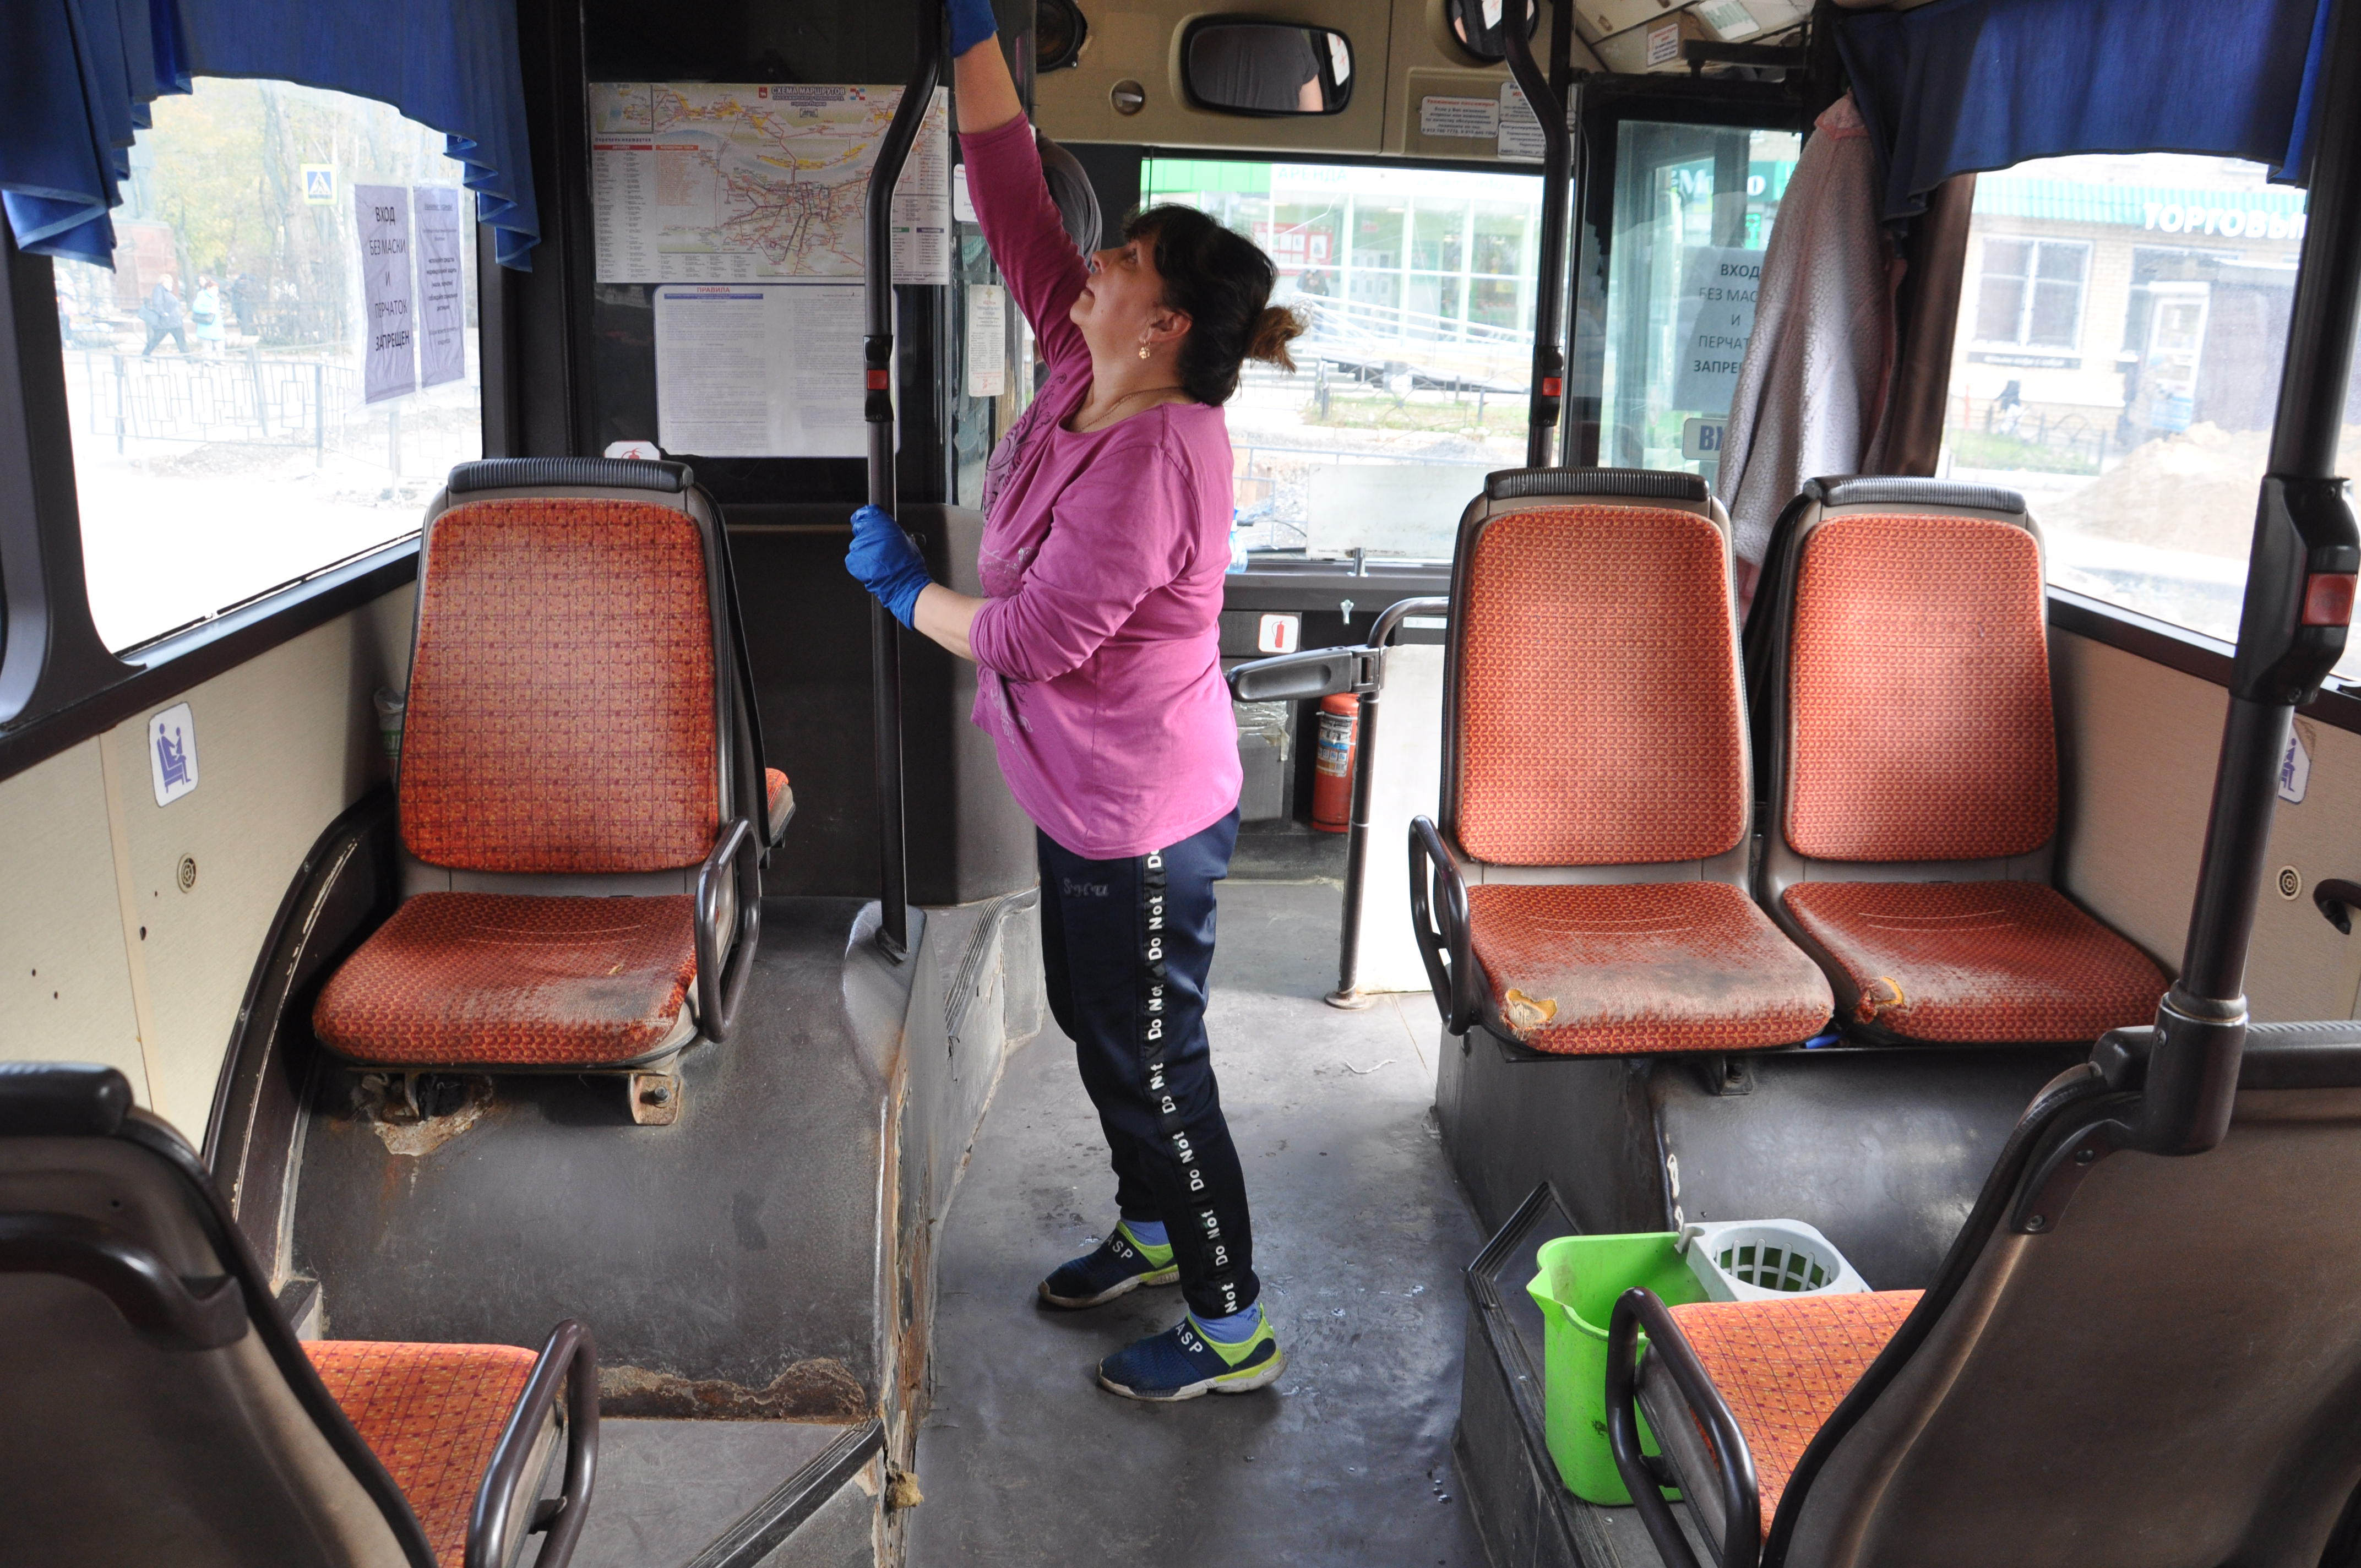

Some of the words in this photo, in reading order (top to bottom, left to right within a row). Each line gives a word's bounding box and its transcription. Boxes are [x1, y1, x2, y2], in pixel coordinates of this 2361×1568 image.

[772, 86, 797, 95] СХЕМА
[799, 86, 846, 95] МАРШРУТОВ
[1277, 166, 1347, 183] АРЕНДА
[376, 206, 396, 226] ВХОД
[369, 239, 382, 256] БЕЗ
[382, 238, 406, 255] МАСКИ
[385, 271, 391, 287] И
[1721, 264, 1760, 280] ВХОД
[1699, 287, 1722, 300] БЕЗ
[1727, 289, 1759, 302] МАС
[374, 298, 407, 319] ПЕРЧАТОК
[1731, 314, 1740, 326] И
[376, 330, 410, 352] ЗАПРЕЩЕН
[1699, 335, 1749, 350] ПЕРЧАТ
[1694, 360, 1742, 374] ЗАПРЕ
[1699, 425, 1724, 451] ВХ
[1149, 895, 1163, 930] Not
[1149, 937, 1162, 961] Do
[1148, 984, 1164, 1012] Not
[1148, 1019, 1162, 1040] Do
[1162, 1095, 1177, 1114] Do
[1172, 1131, 1194, 1164] Not
[1190, 1169, 1204, 1192] Do
[1201, 1209, 1220, 1240] Not
[1215, 1245, 1228, 1266] Do
[1221, 1282, 1238, 1314] Not
[1175, 1322, 1203, 1353] ASP
